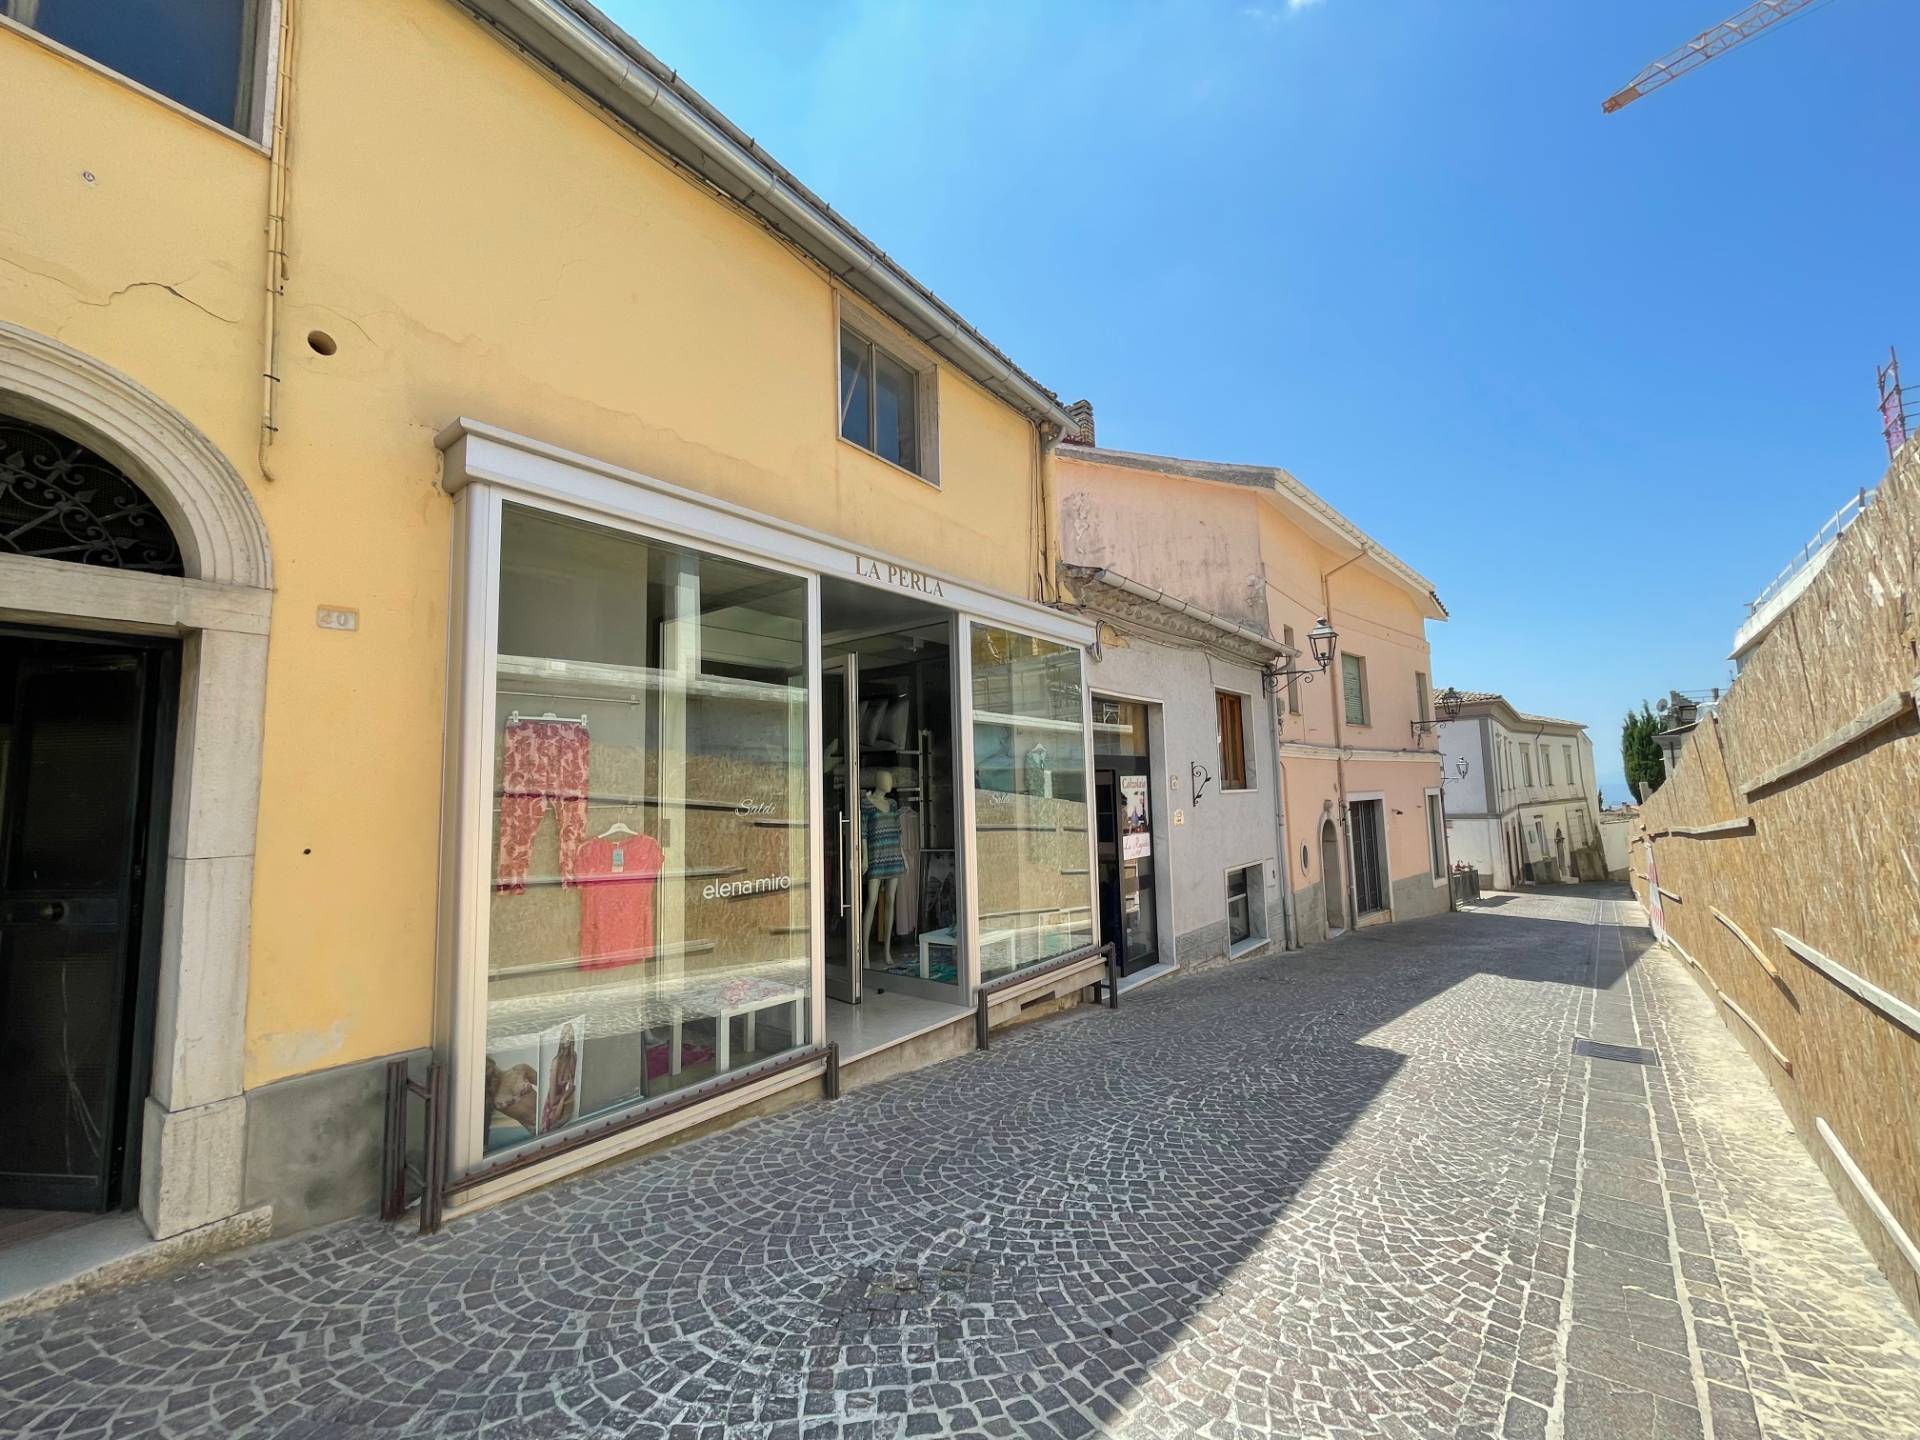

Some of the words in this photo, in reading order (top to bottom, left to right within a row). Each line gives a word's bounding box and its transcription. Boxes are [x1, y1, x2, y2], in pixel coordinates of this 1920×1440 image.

[856, 556, 881, 580] LA
[887, 563, 944, 598] PERLA
[735, 799, 777, 816] Saldi
[703, 878, 752, 899] elena
[755, 874, 791, 893] miro
